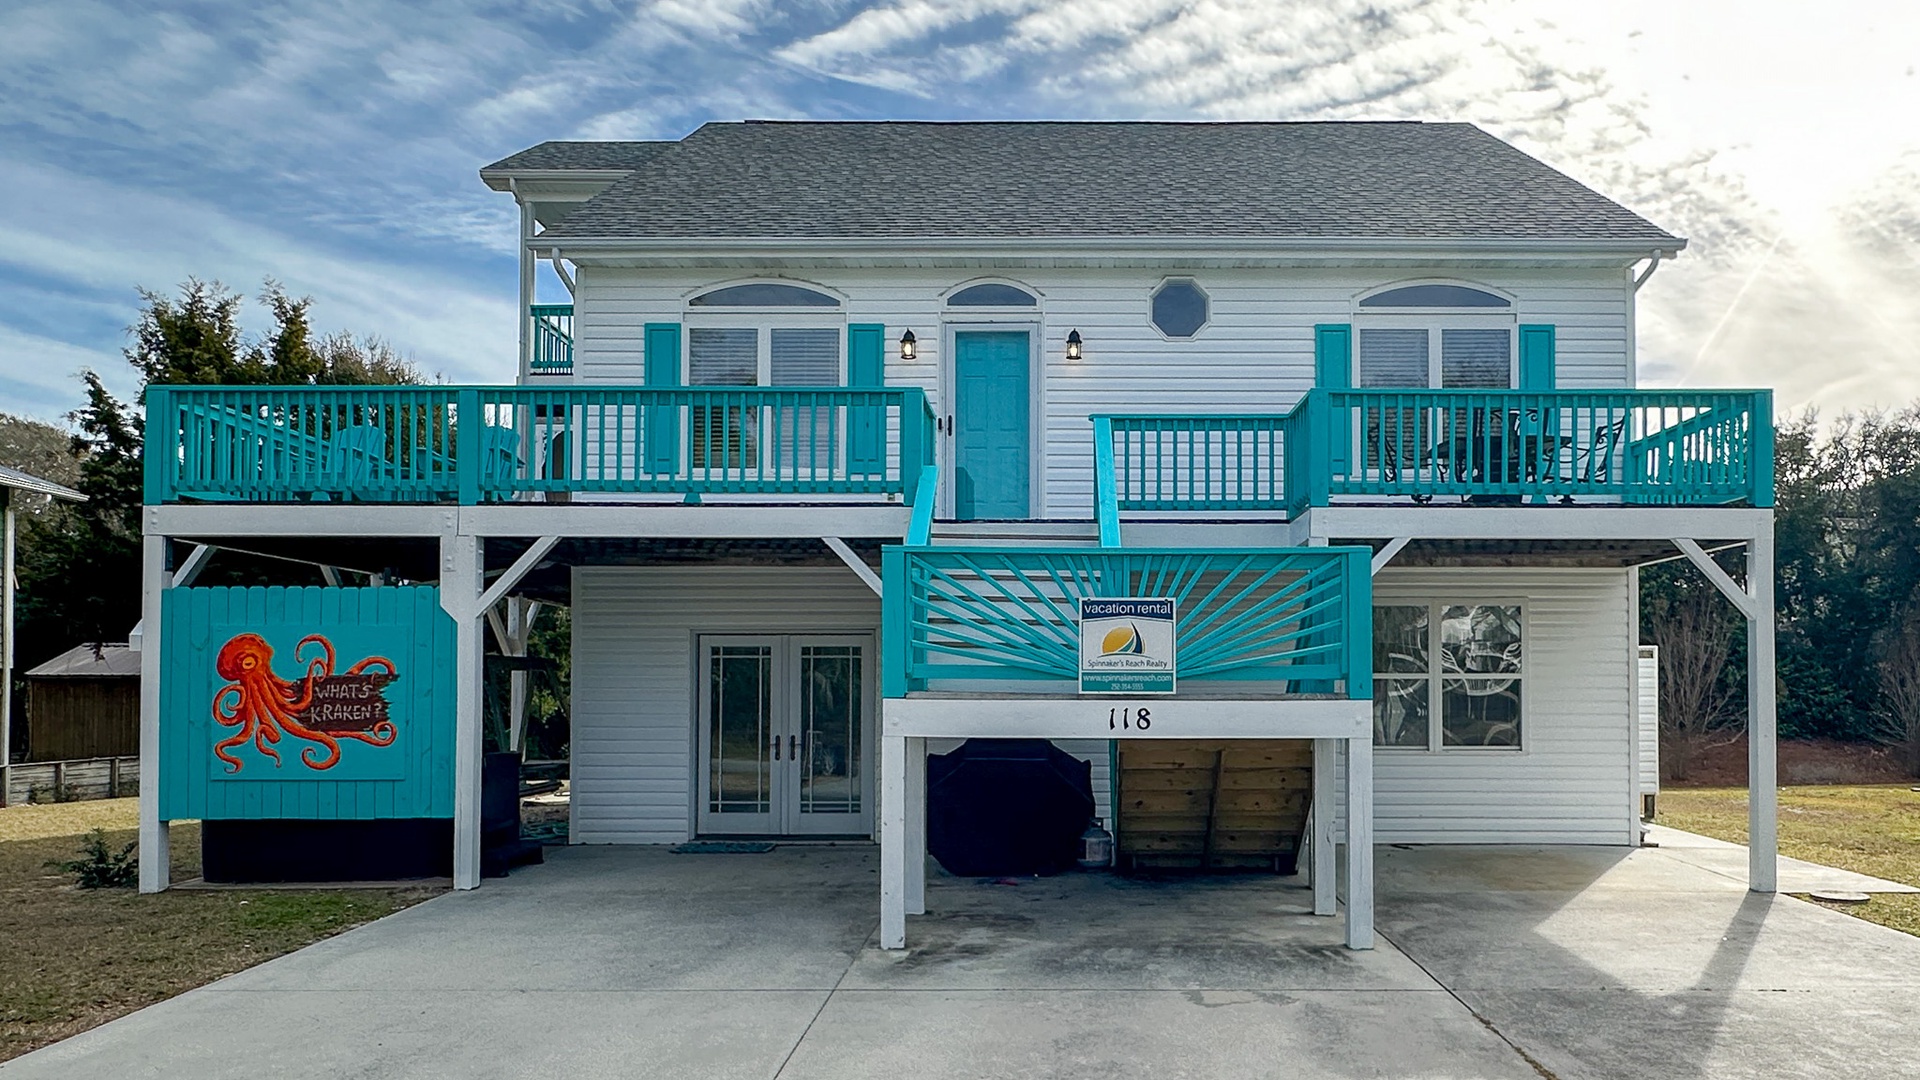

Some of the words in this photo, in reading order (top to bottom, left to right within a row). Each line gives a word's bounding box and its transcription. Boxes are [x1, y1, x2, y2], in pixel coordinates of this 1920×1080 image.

[1084, 602, 1135, 614] vacation
[1137, 602, 1171, 614] rental
[1087, 659, 1124, 668] Spinnaker's
[1125, 659, 1145, 667] Reach
[1146, 659, 1168, 669] Realty
[314, 681, 373, 699] WHAT'S
[1109, 707, 1151, 731] 118
